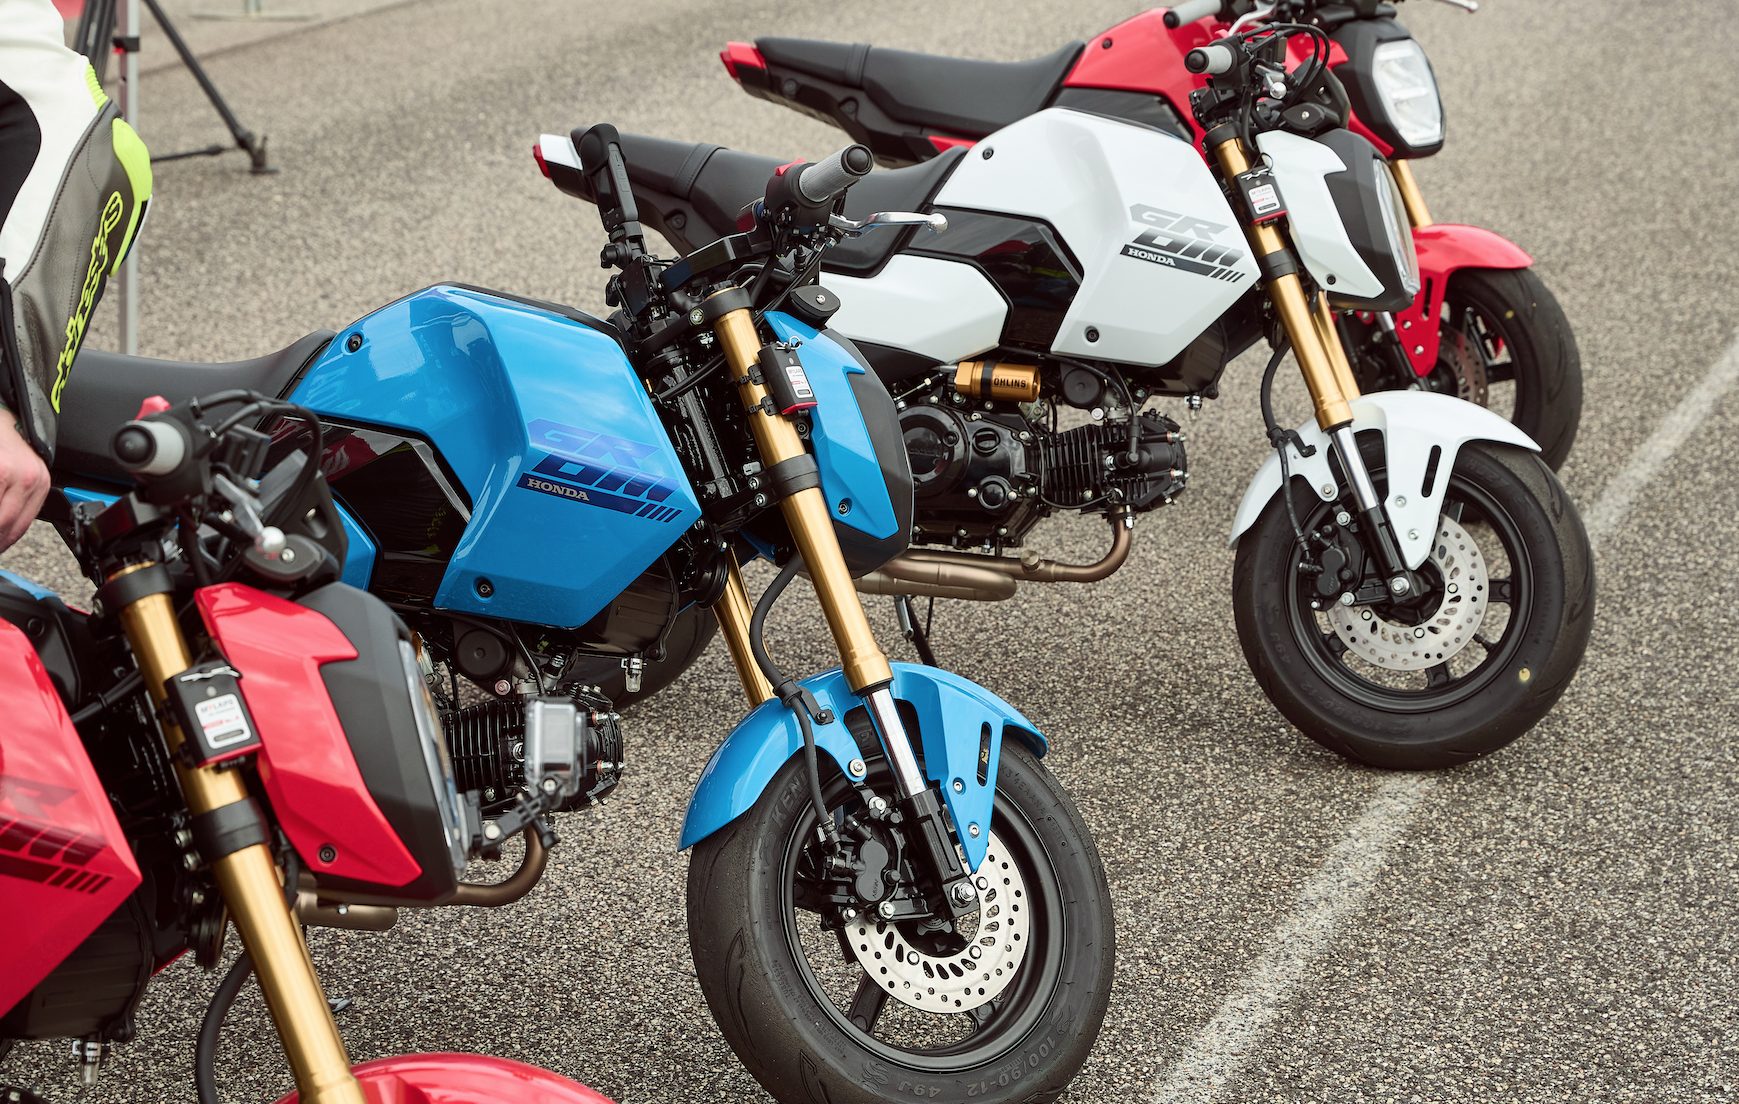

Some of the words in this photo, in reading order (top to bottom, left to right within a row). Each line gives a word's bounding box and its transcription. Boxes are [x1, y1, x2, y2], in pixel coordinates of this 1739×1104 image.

[1130, 203, 1229, 241] GR
[1128, 248, 1176, 267] HONDA
[528, 418, 662, 470] GR
[527, 478, 590, 501] HONDA
[967, 1036, 1056, 1098] 100/90-12
[898, 1080, 942, 1098] 49J
